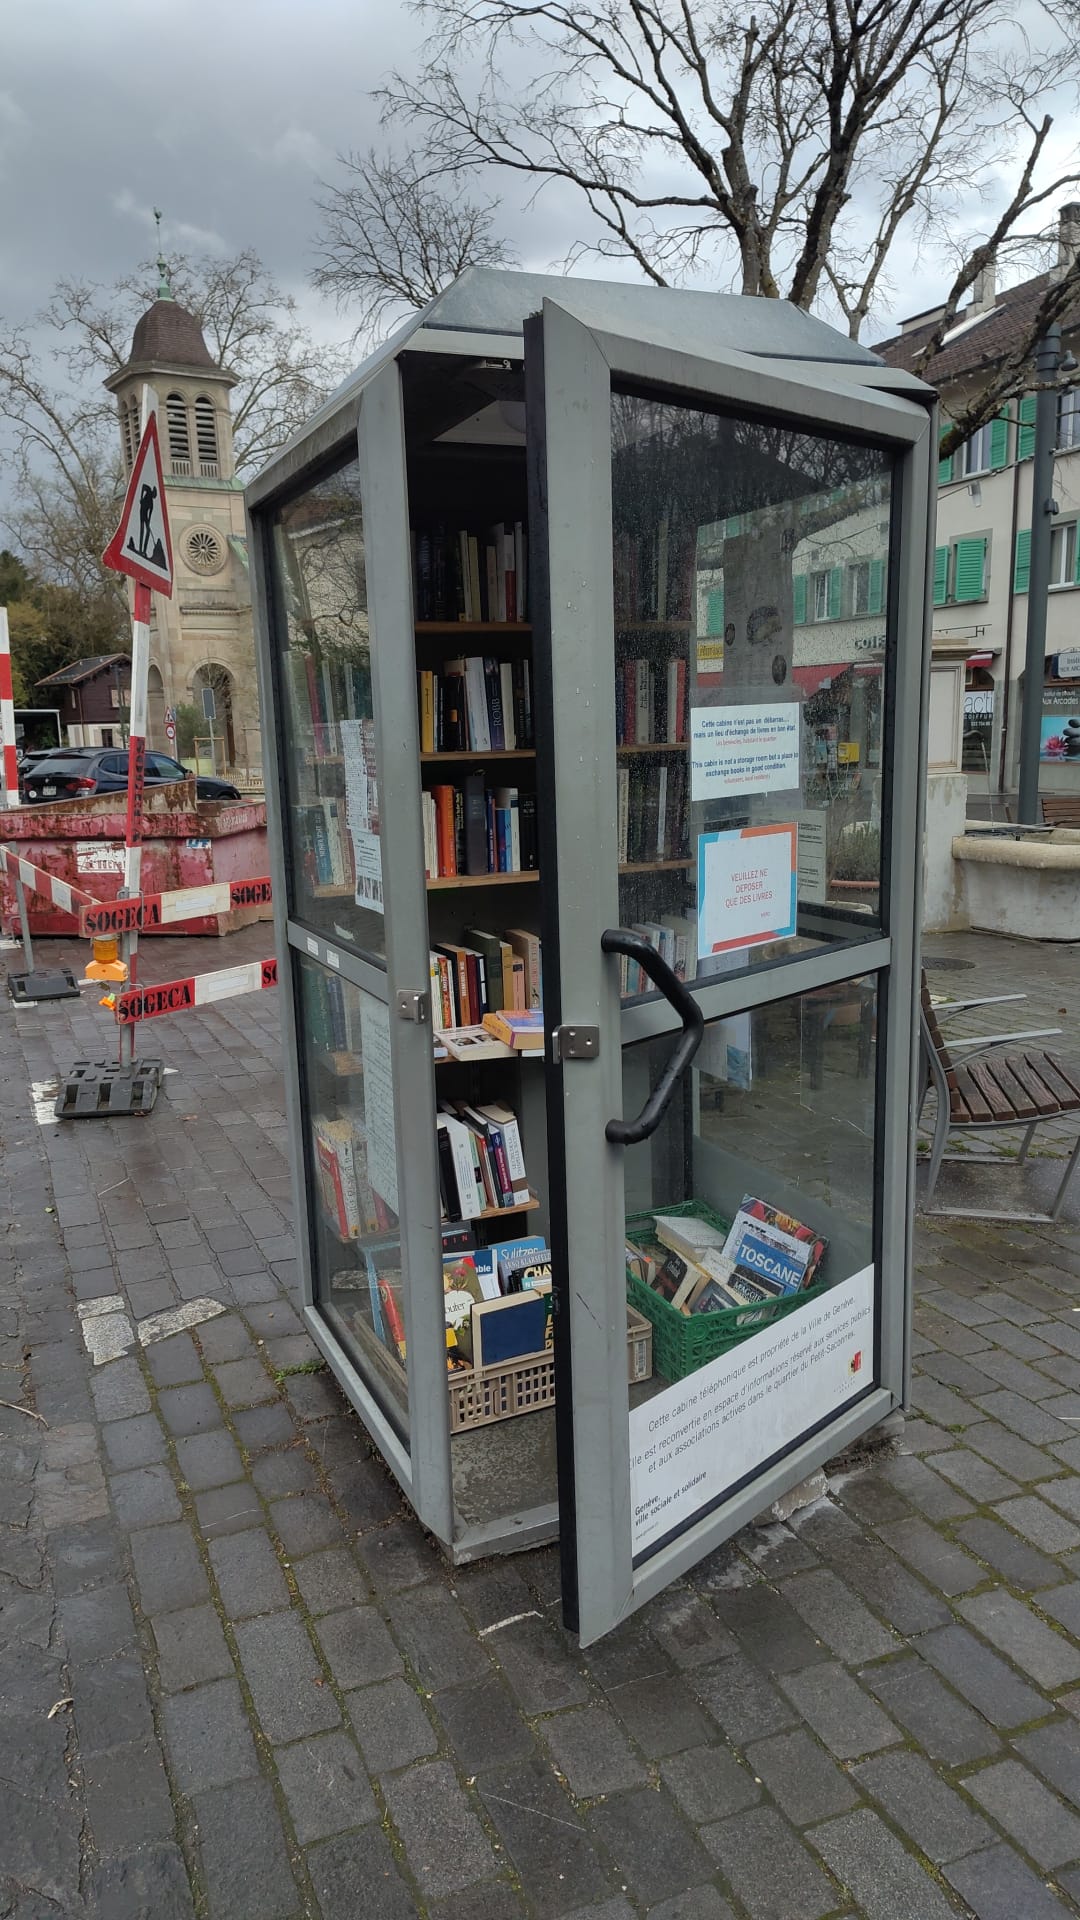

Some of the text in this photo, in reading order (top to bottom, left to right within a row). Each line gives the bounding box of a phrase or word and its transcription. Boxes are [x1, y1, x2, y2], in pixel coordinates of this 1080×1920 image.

[731, 868, 768, 882] VEUILLEZ NE
[85, 903, 161, 934] SOGECA
[725, 891, 772, 908] QUE DES LIVRES
[119, 984, 192, 1021] SOGECA
[740, 1244, 800, 1287] TOSCANE
[644, 1444, 656, 1460] est
[659, 1417, 701, 1450] reconvertie
[703, 1409, 712, 1421] en
[714, 1392, 739, 1414] espace
[741, 1359, 789, 1396] d'informations
[790, 1342, 812, 1362] réservé
[814, 1336, 825, 1349] aux
[826, 1320, 849, 1341] services
[850, 1306, 871, 1327] publics
[648, 1413, 669, 1432] Cette
[672, 1396, 698, 1417] cabine
[700, 1364, 746, 1400] téléphonique
[748, 1355, 758, 1369] est
[760, 1336, 789, 1363] propriété
[791, 1330, 799, 1342] de
[801, 1326, 806, 1336] la
[808, 1316, 822, 1331] Ville
[824, 1311, 830, 1321] de
[648, 1461, 656, 1473] et
[659, 1452, 672, 1467] aux
[674, 1419, 720, 1456] associations
[722, 1402, 746, 1424] actives
[747, 1390, 764, 1406] dans
[766, 1384, 772, 1393] le
[774, 1367, 799, 1390] quartier
[800, 1361, 808, 1372] du
[635, 1472, 706, 1526] ville sociale et solidaire
